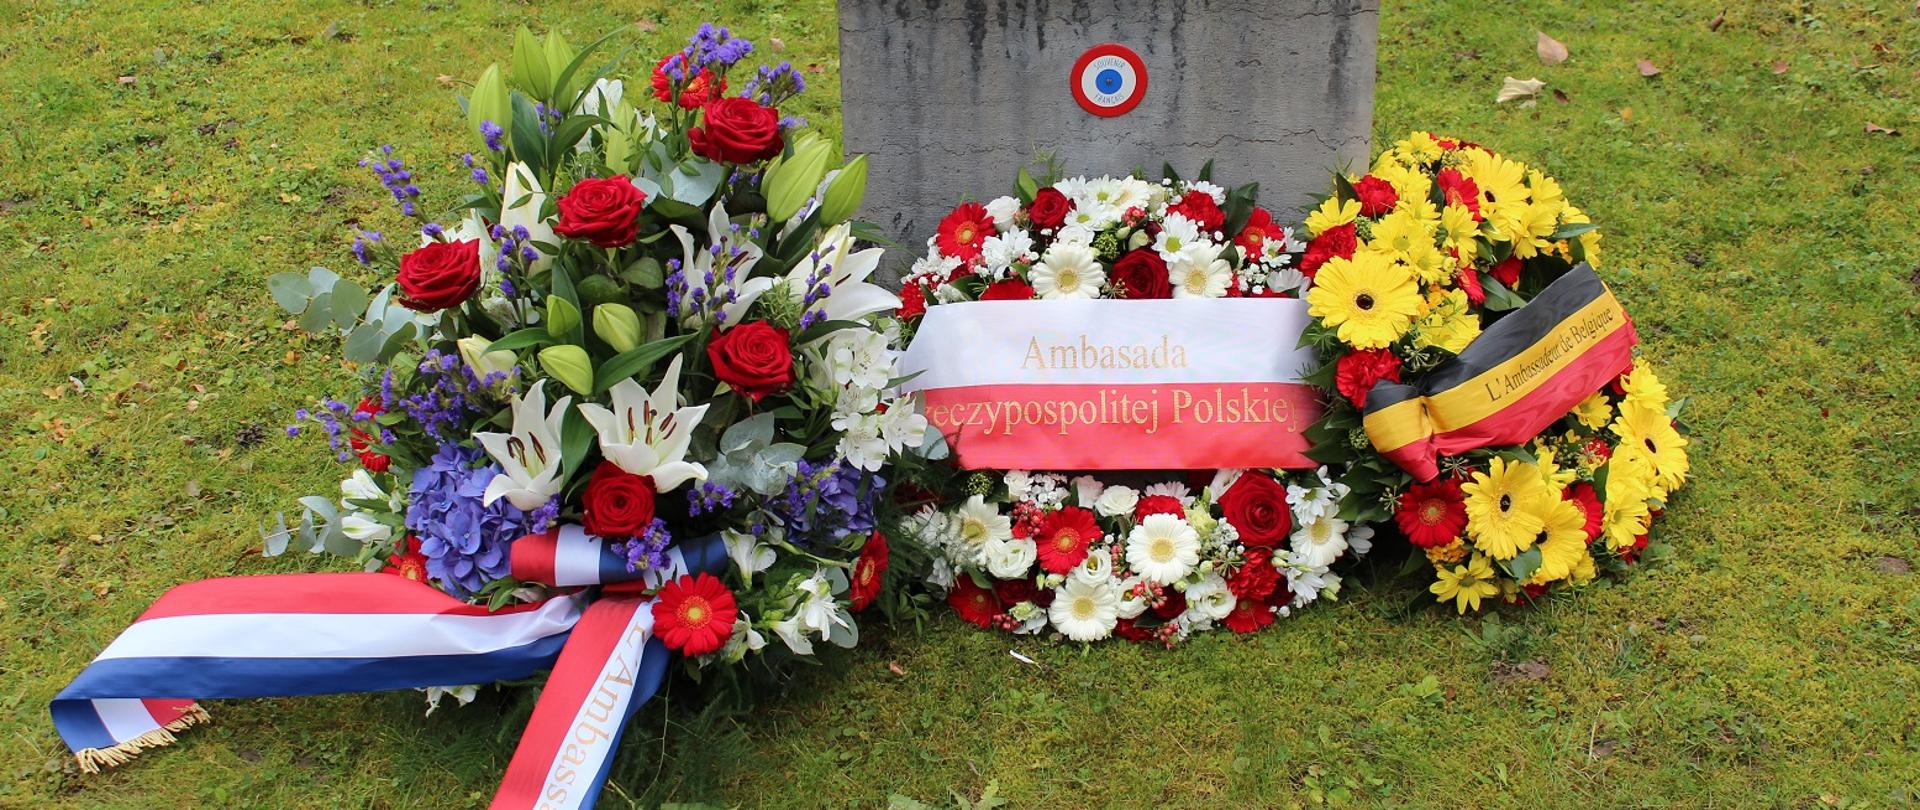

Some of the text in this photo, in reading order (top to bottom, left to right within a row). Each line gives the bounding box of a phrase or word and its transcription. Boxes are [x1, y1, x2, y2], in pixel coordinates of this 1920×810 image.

[1093, 57, 1126, 70] SOUVENIR
[1560, 334, 1574, 353] de
[1570, 308, 1613, 344] Belgique
[1021, 334, 1190, 370] Ambasada
[1171, 387, 1296, 433] Polskiej
